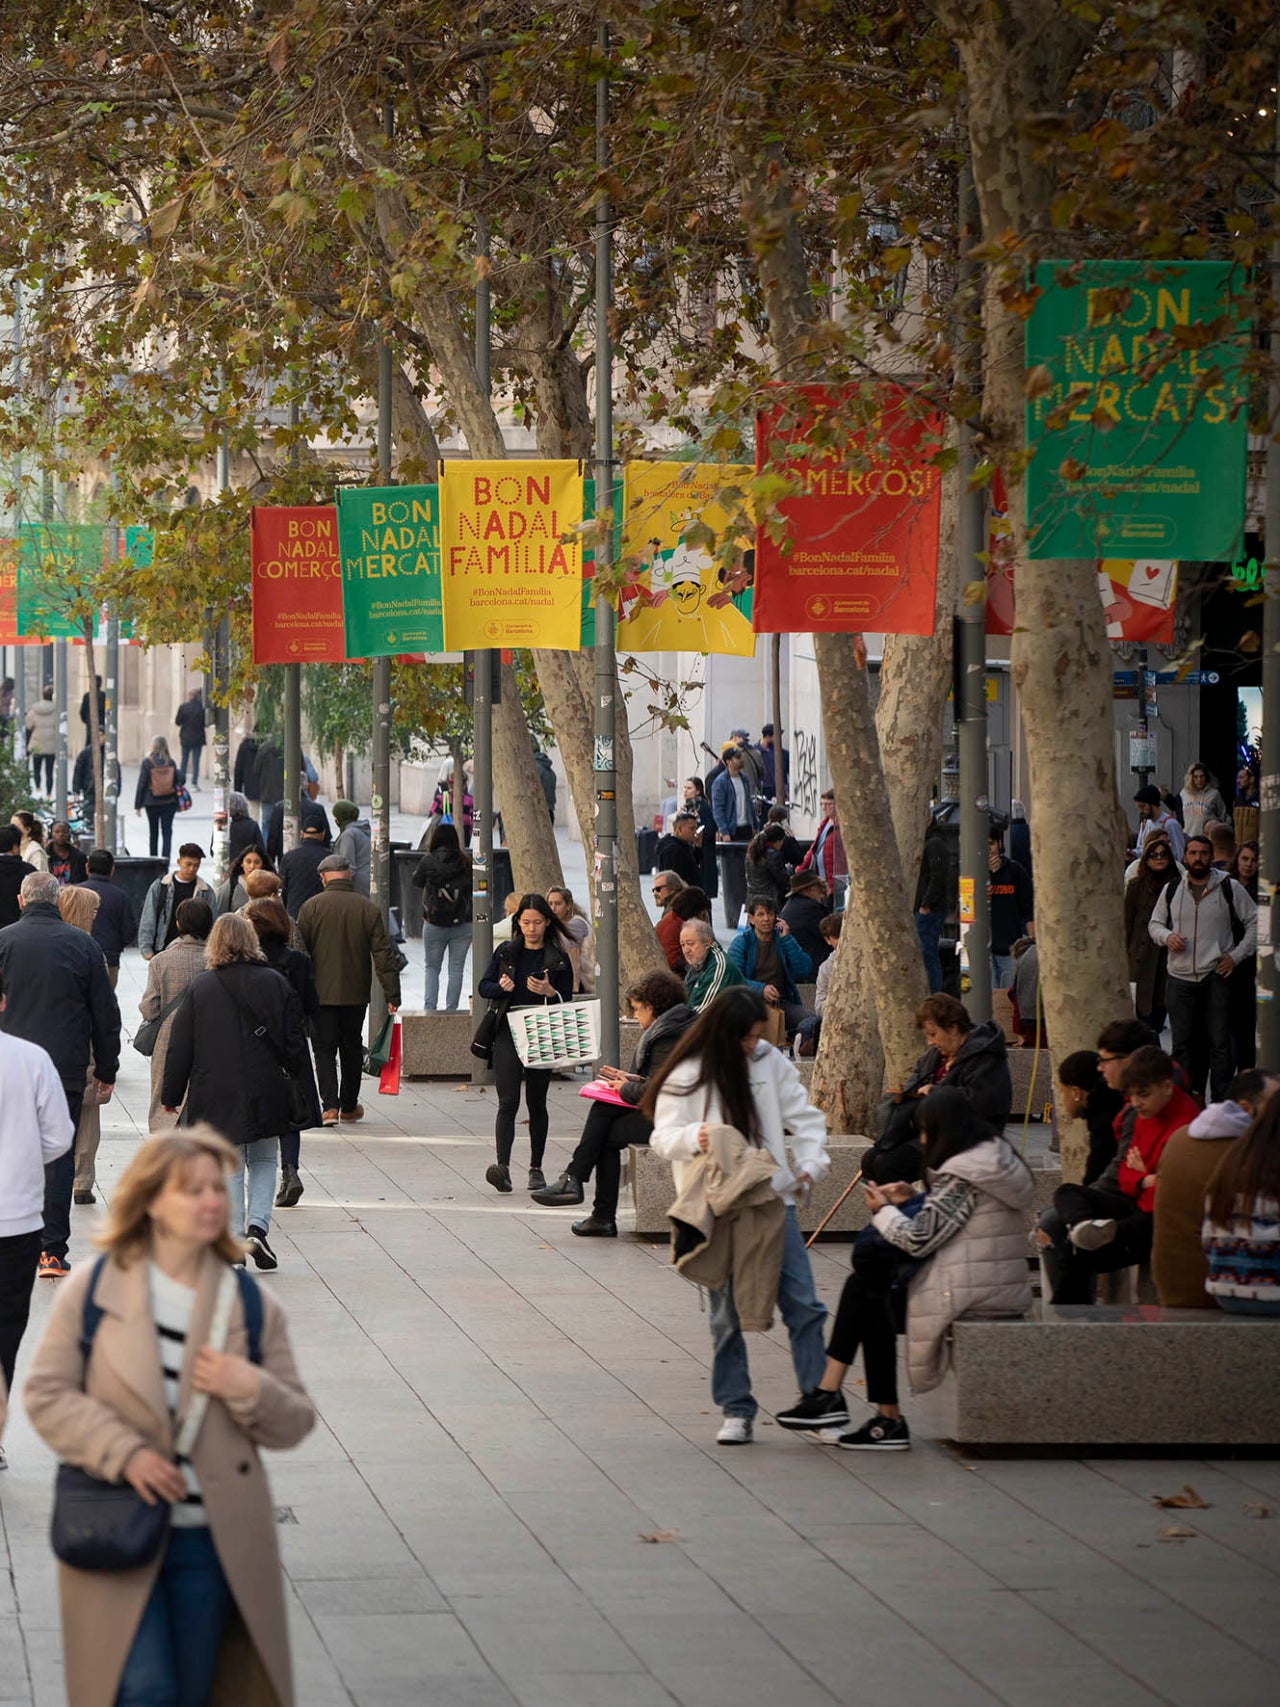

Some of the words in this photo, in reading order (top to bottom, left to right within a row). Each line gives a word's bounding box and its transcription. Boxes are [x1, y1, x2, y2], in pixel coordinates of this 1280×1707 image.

[474, 475, 550, 506] BON
[372, 499, 431, 525] BON
[288, 520, 331, 537] BON
[449, 540, 577, 576] FAMÍLIA!
[788, 565, 899, 576] barcelona.cat/nadal
[469, 598, 555, 607] barcelona.cat/nadal
